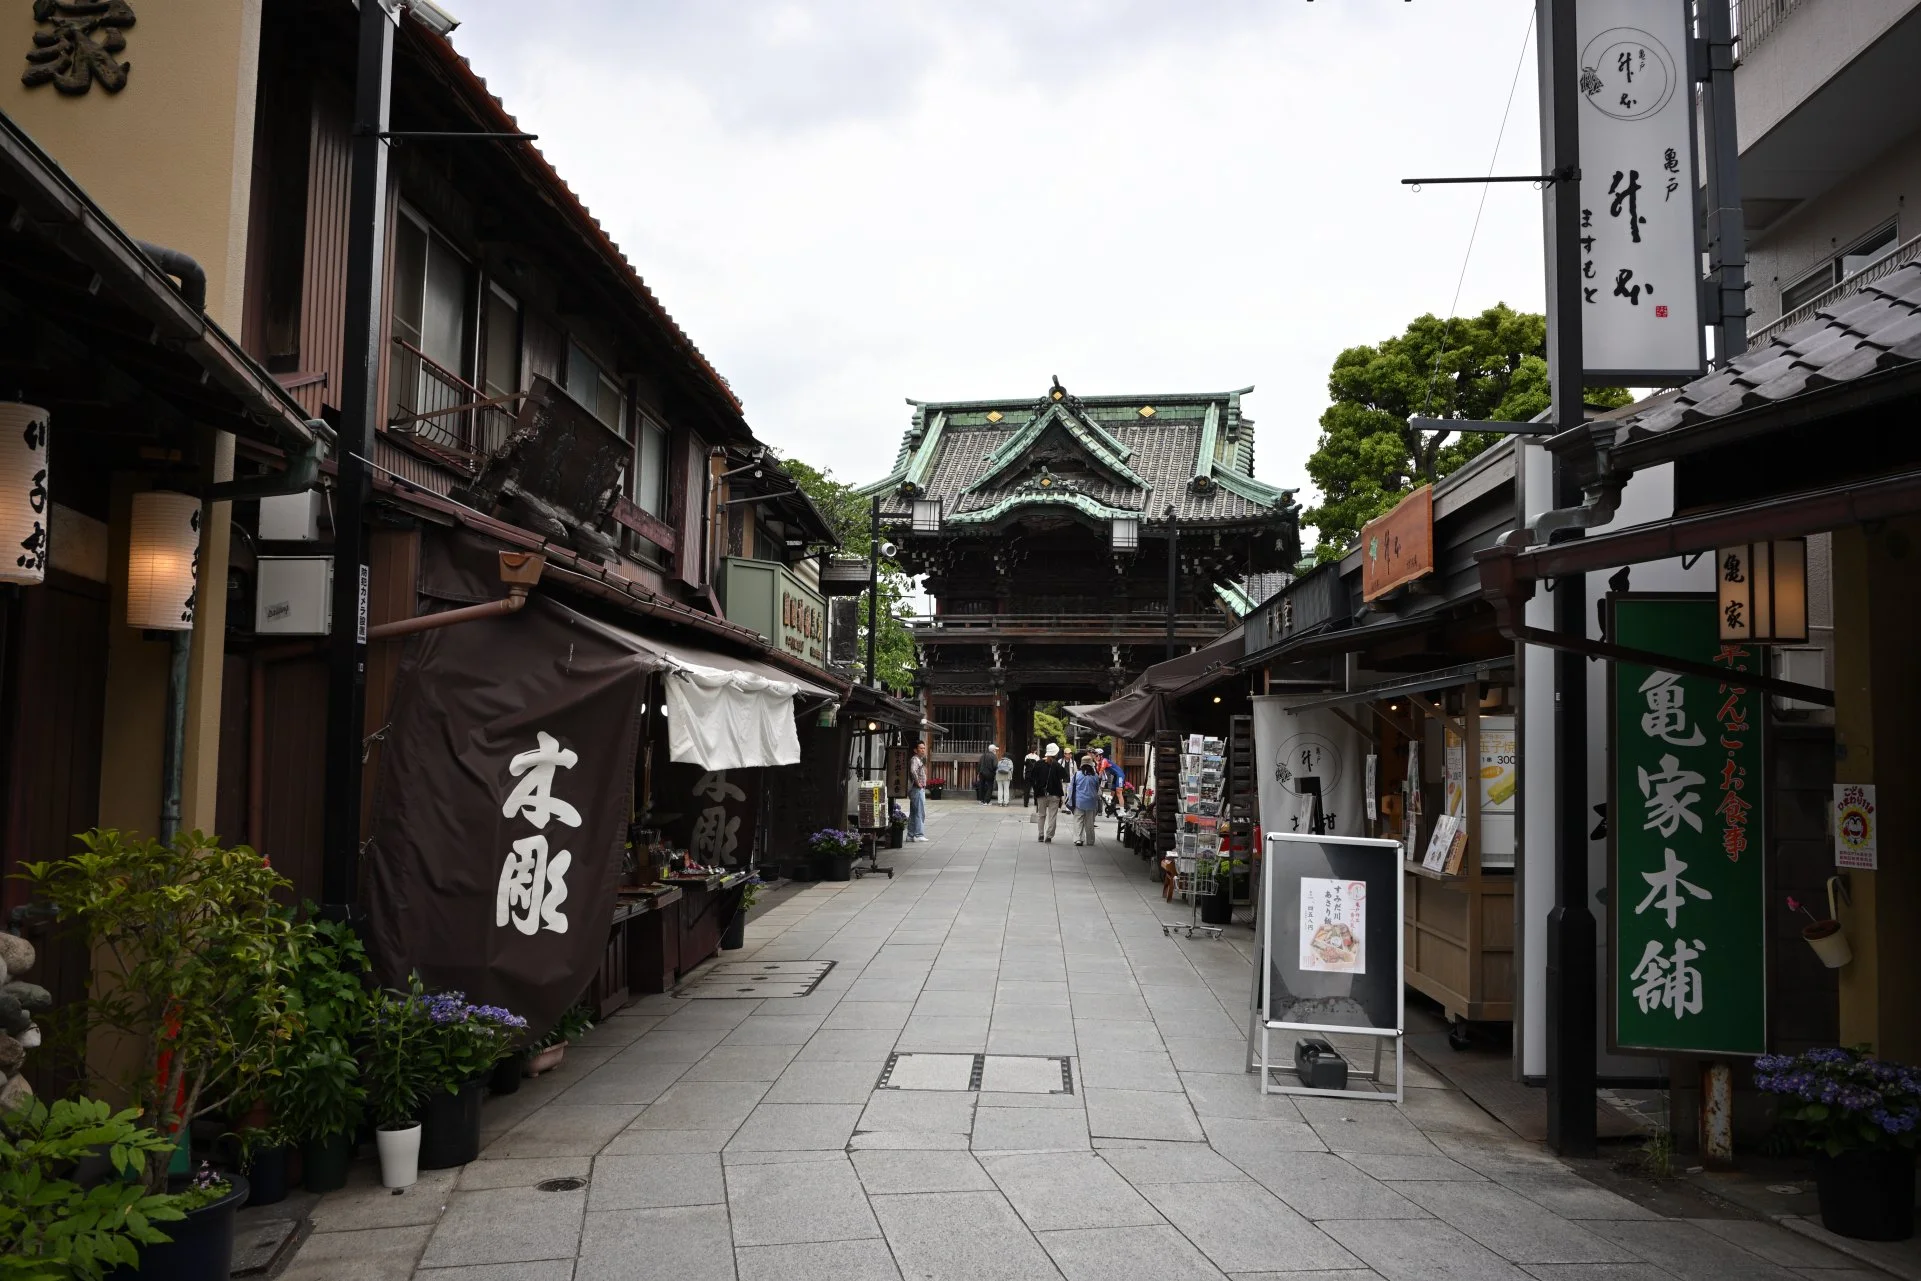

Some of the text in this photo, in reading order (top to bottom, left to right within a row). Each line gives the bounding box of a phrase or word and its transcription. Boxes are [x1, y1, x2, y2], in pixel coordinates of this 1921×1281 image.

[1663, 147, 1681, 203] 亀戸
[1580, 208, 1598, 304] ますもと
[1723, 552, 1745, 630] 亀家
[1497, 755, 1516, 764] 300
[1843, 785, 1865, 797] こども
[1630, 670, 1713, 1021] 亀家本舗
[1333, 885, 1342, 921] すみだ川
